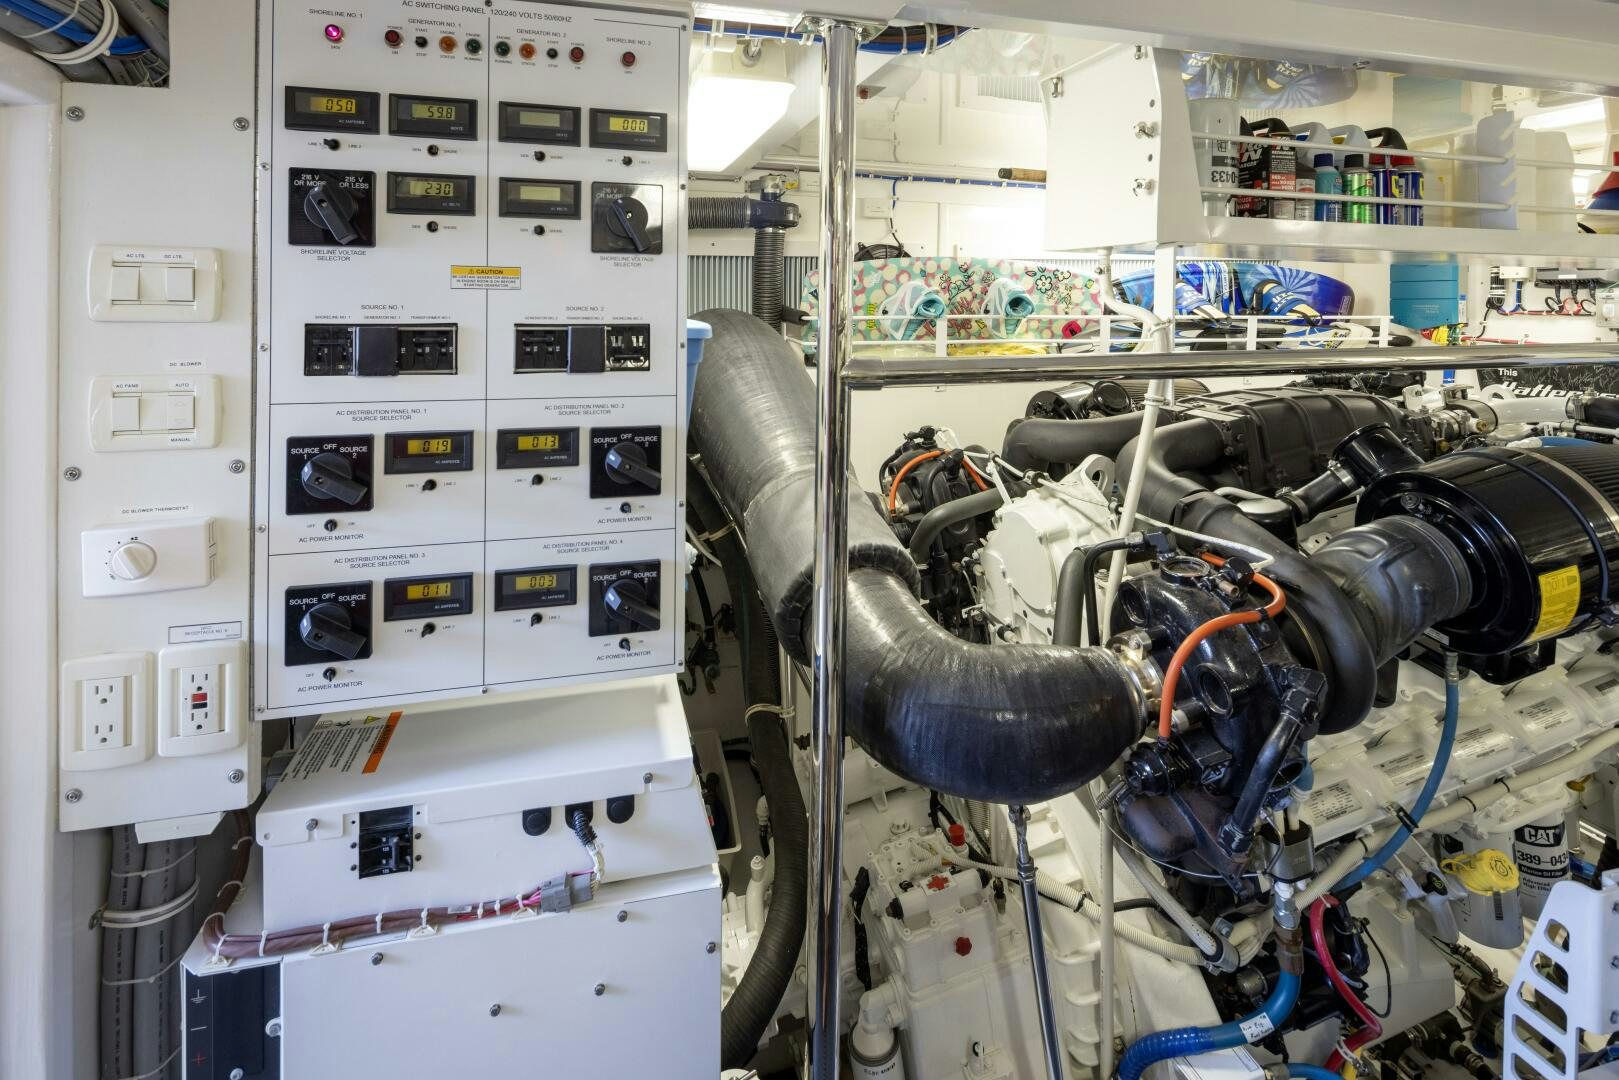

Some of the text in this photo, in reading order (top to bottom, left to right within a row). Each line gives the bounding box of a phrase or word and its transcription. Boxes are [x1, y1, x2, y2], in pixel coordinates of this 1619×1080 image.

[309, 8, 345, 18] SHORELINE
[415, 1, 460, 12] SWITCHING
[461, 4, 486, 15] PANEL
[490, 9, 517, 18] 120/240
[519, 12, 542, 20] VOLTS
[408, 18, 446, 27] GENERATOR
[516, 28, 549, 37] GENERATOR
[606, 36, 636, 45] SHORELINE
[325, 98, 353, 112] 050
[427, 106, 453, 119] 59.8
[622, 119, 646, 132] 000
[338, 181, 350, 189] OR
[424, 182, 451, 196] 230
[300, 248, 337, 256] SHORELINE
[1498, 368, 1518, 377] This
[346, 408, 390, 416] DISTRIBUTION
[422, 440, 448, 453] 019
[532, 436, 557, 448] 013
[290, 447, 320, 455] SOURCE
[323, 443, 338, 451] OFF
[309, 535, 333, 543] POWER
[334, 533, 364, 541] MONITOR
[552, 541, 590, 549] DISTRIBUTION
[581, 545, 610, 553] SELECTOR
[344, 555, 388, 563] DISTRIBUTION
[377, 560, 410, 568] SELECTOR
[619, 569, 632, 577] OFF
[633, 571, 657, 579] SOURCE
[529, 575, 554, 588] 003
[422, 584, 450, 597] 011
[289, 592, 367, 605] SOURCE OFF SOURCE
[626, 650, 651, 658] MONITOR
[308, 684, 332, 692] POWER
[333, 681, 363, 689] MONITOR
[1524, 827, 1555, 845] CAT
[1521, 865, 1542, 876] Marine
[1522, 877, 1550, 887] Advanced
